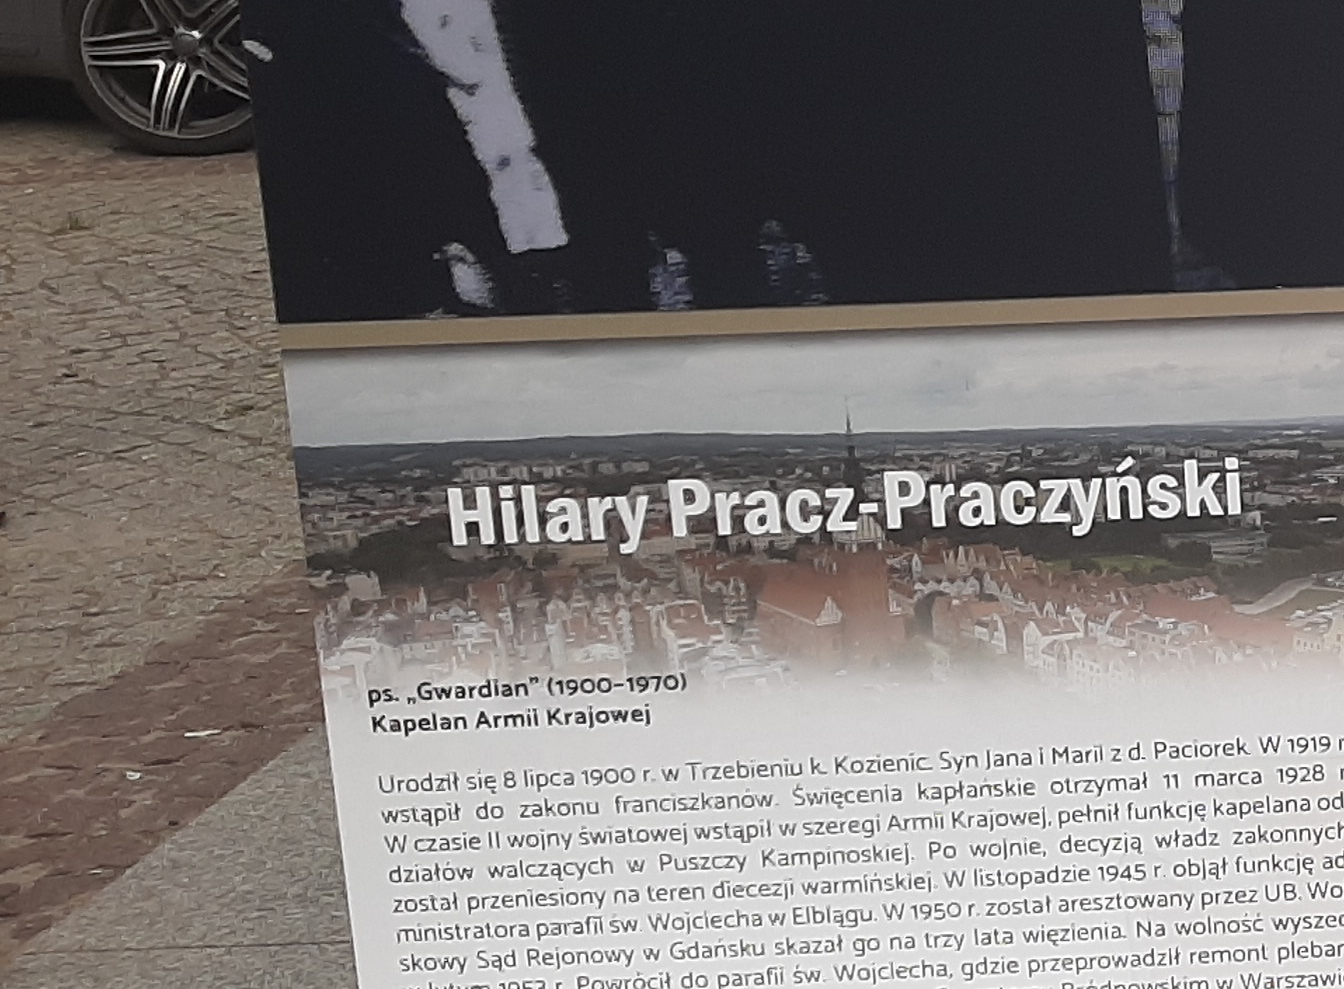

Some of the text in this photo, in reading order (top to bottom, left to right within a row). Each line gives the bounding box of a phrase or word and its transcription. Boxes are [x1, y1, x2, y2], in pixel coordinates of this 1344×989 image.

[445, 456, 1242, 554] Hilary Pracz-Praczyński
[367, 671, 687, 708] ps. „Gwardian” (1900–1970)
[370, 704, 651, 738] Kapelan Armii Krajowej
[376, 770, 460, 799] Urodził
[464, 767, 502, 795] się
[503, 768, 517, 789] 8
[522, 767, 575, 794] lipca
[580, 766, 637, 787] 1900
[640, 769, 657, 783] r.
[660, 765, 680, 783] w
[684, 756, 804, 782] Trzebieniu
[938, 750, 979, 775] Syn
[985, 748, 1033, 771] Jana
[1038, 746, 1044, 766] i
[1051, 743, 1104, 765] Marii
[1110, 747, 1123, 763] z
[1128, 741, 1147, 761] d.
[1258, 734, 1282, 755] W
[1283, 735, 1332, 755] 1919
[379, 801, 462, 828] wstąpił
[475, 800, 505, 820] do
[519, 796, 600, 819] zakonu
[614, 787, 780, 815] franciszkanów.
[791, 782, 903, 810] Święcenia
[917, 776, 1036, 806] kapłańskie
[1050, 770, 1148, 799] otrzymał
[1162, 773, 1179, 790] 11
[1194, 770, 1263, 788] marca
[1275, 763, 1325, 785] 1928
[383, 830, 414, 859] W
[413, 827, 483, 858] czasie
[487, 826, 501, 850] II
[506, 827, 574, 852] wojny
[578, 822, 688, 847] światowej
[693, 818, 775, 844] wstąpił
[778, 821, 798, 837] w
[802, 812, 881, 839] szeregi
[886, 810, 945, 833] Armii
[951, 805, 1052, 833] Krajowej,
[1057, 801, 1120, 830] pełnił
[1127, 799, 1207, 824] funkcję
[1212, 794, 1311, 820] kapelana
[387, 858, 475, 890] działów
[485, 855, 614, 882] walczących
[626, 859, 646, 874] w
[658, 853, 748, 874] Puszczy
[761, 841, 919, 871] Kampinoskiej.
[928, 840, 957, 861] Po
[968, 836, 1047, 861] wojnie,
[1059, 831, 1144, 858] decyzją
[1154, 826, 1221, 849] władz
[390, 887, 462, 919] został
[466, 886, 607, 917] przeniesiony
[613, 888, 640, 905] na
[646, 884, 706, 903] teren
[712, 877, 795, 902] diecezji
[800, 870, 939, 896] warmińskiej.
[941, 866, 967, 889] W
[973, 863, 1092, 891] listopadzie
[1097, 863, 1147, 883] 1945
[1153, 863, 1166, 879] r.
[1172, 856, 1229, 882] objął
[1234, 851, 1315, 877] funkcję
[394, 918, 531, 949] ministratora
[536, 914, 607, 942] parafii
[647, 908, 763, 936] Wojciecha
[767, 911, 787, 927] w
[791, 904, 878, 929] Elblągu.
[881, 900, 906, 922] W
[909, 901, 962, 921] 1950
[967, 902, 981, 918] r.
[985, 894, 1052, 917] został
[1058, 891, 1196, 913] aresztowany
[1200, 889, 1259, 912] przez
[1264, 882, 1303, 903] UB.
[397, 948, 469, 978] skowy
[475, 948, 517, 974] Sąd
[526, 946, 635, 971] Rejonowy
[642, 947, 661, 962] w
[669, 937, 766, 961] Gdańsku
[774, 933, 844, 956] skazał
[852, 937, 881, 958] go
[889, 935, 916, 951] na
[923, 932, 965, 952] trzy
[973, 927, 1014, 947] lata
[1136, 916, 1166, 939] Na
[1173, 911, 1264, 937] wolność
[576, 970, 672, 989] Powrócił
[680, 971, 709, 989] do
[717, 965, 785, 989] parafii
[832, 958, 954, 986] Wojciecha,
[960, 955, 1020, 982] gdzie
[1027, 945, 1182, 979] przeprowadził
[1189, 942, 1269, 966] remont
